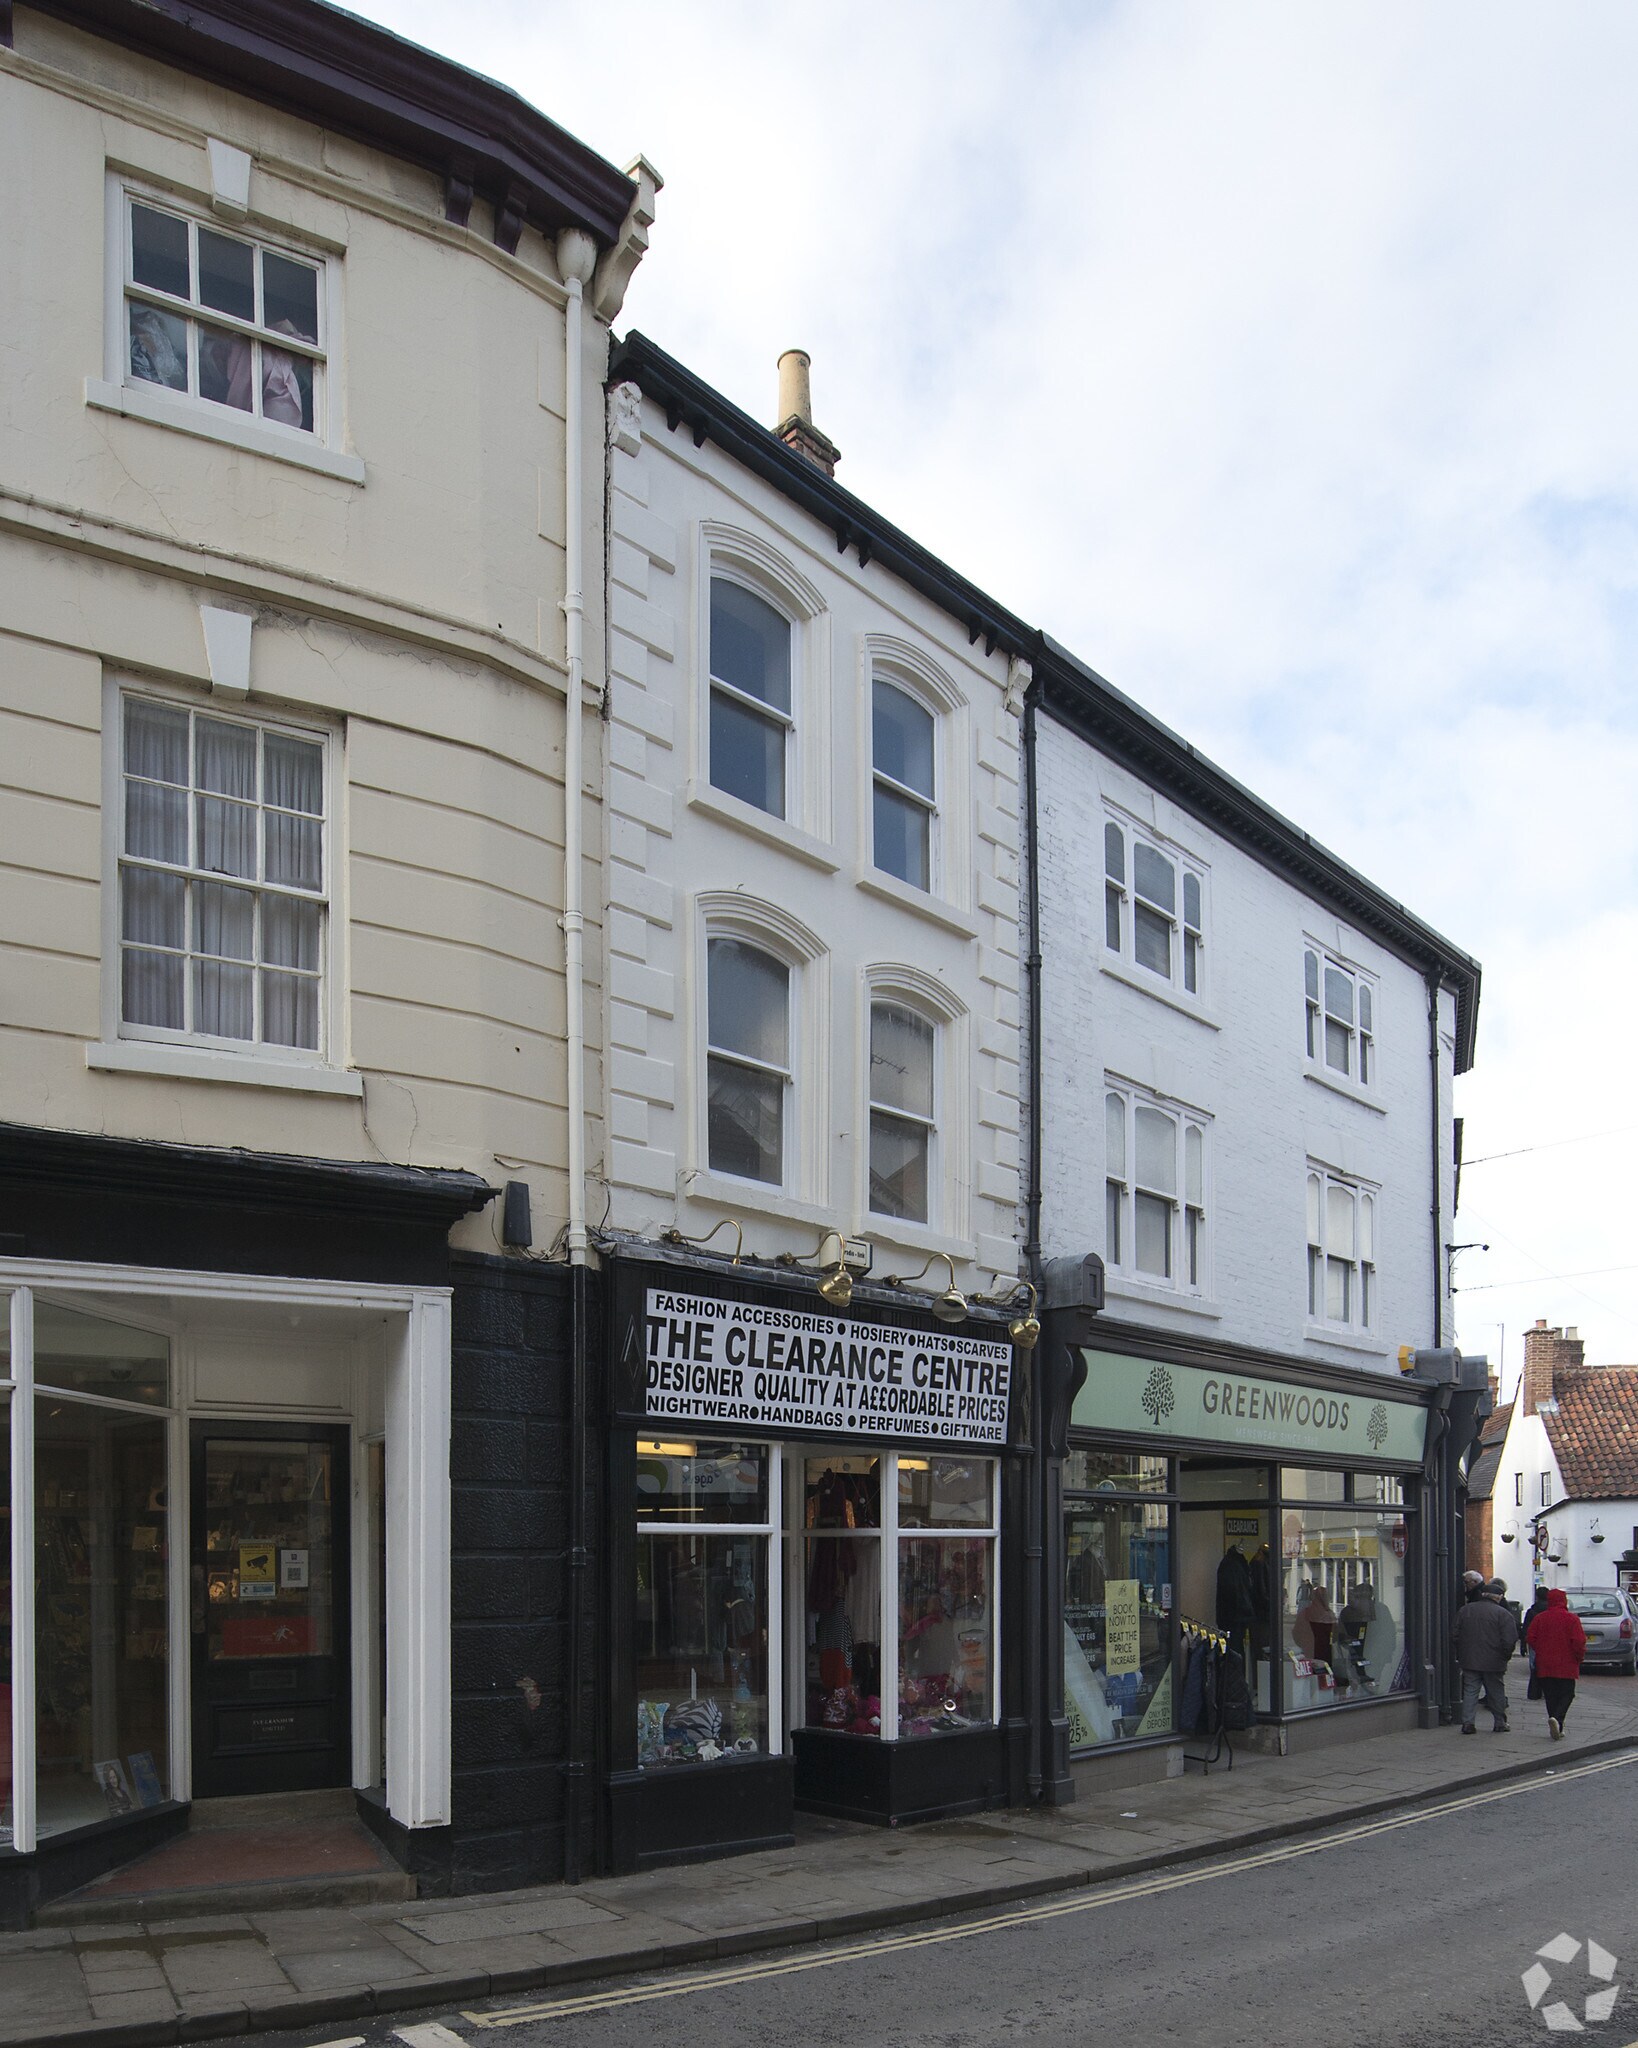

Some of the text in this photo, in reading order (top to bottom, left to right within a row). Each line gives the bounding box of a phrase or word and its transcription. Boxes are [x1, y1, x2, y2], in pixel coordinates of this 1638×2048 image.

[656, 1294, 1008, 1360] FASHION ACCESSORIES HOSIERY HATS SCARVES
[646, 1315, 1009, 1396] THE CLEARANCE CENTRE
[646, 1360, 1006, 1423] DESIGNER QUALITY AT A££ORDABLE PRICES
[1202, 1380, 1350, 1431] GREENWOODS
[647, 1394, 1002, 1440] NIGHTWEAR HANDBAGS PERFUMES GIFTWARE
[1227, 1520, 1258, 1534] CLEARANCE
[1113, 1604, 1133, 1615] BOOK
[1109, 1615, 1136, 1626] NOW TO
[1109, 1631, 1138, 1643] BEAT THE
[1114, 1643, 1132, 1654] PRICE
[1111, 1654, 1136, 1665] INCREASE
[1295, 1660, 1312, 1677] SALE
[1066, 1714, 1080, 1728] AVE
[1146, 1717, 1170, 1729] DEPOSIT
[1069, 1726, 1088, 1744] 25%
